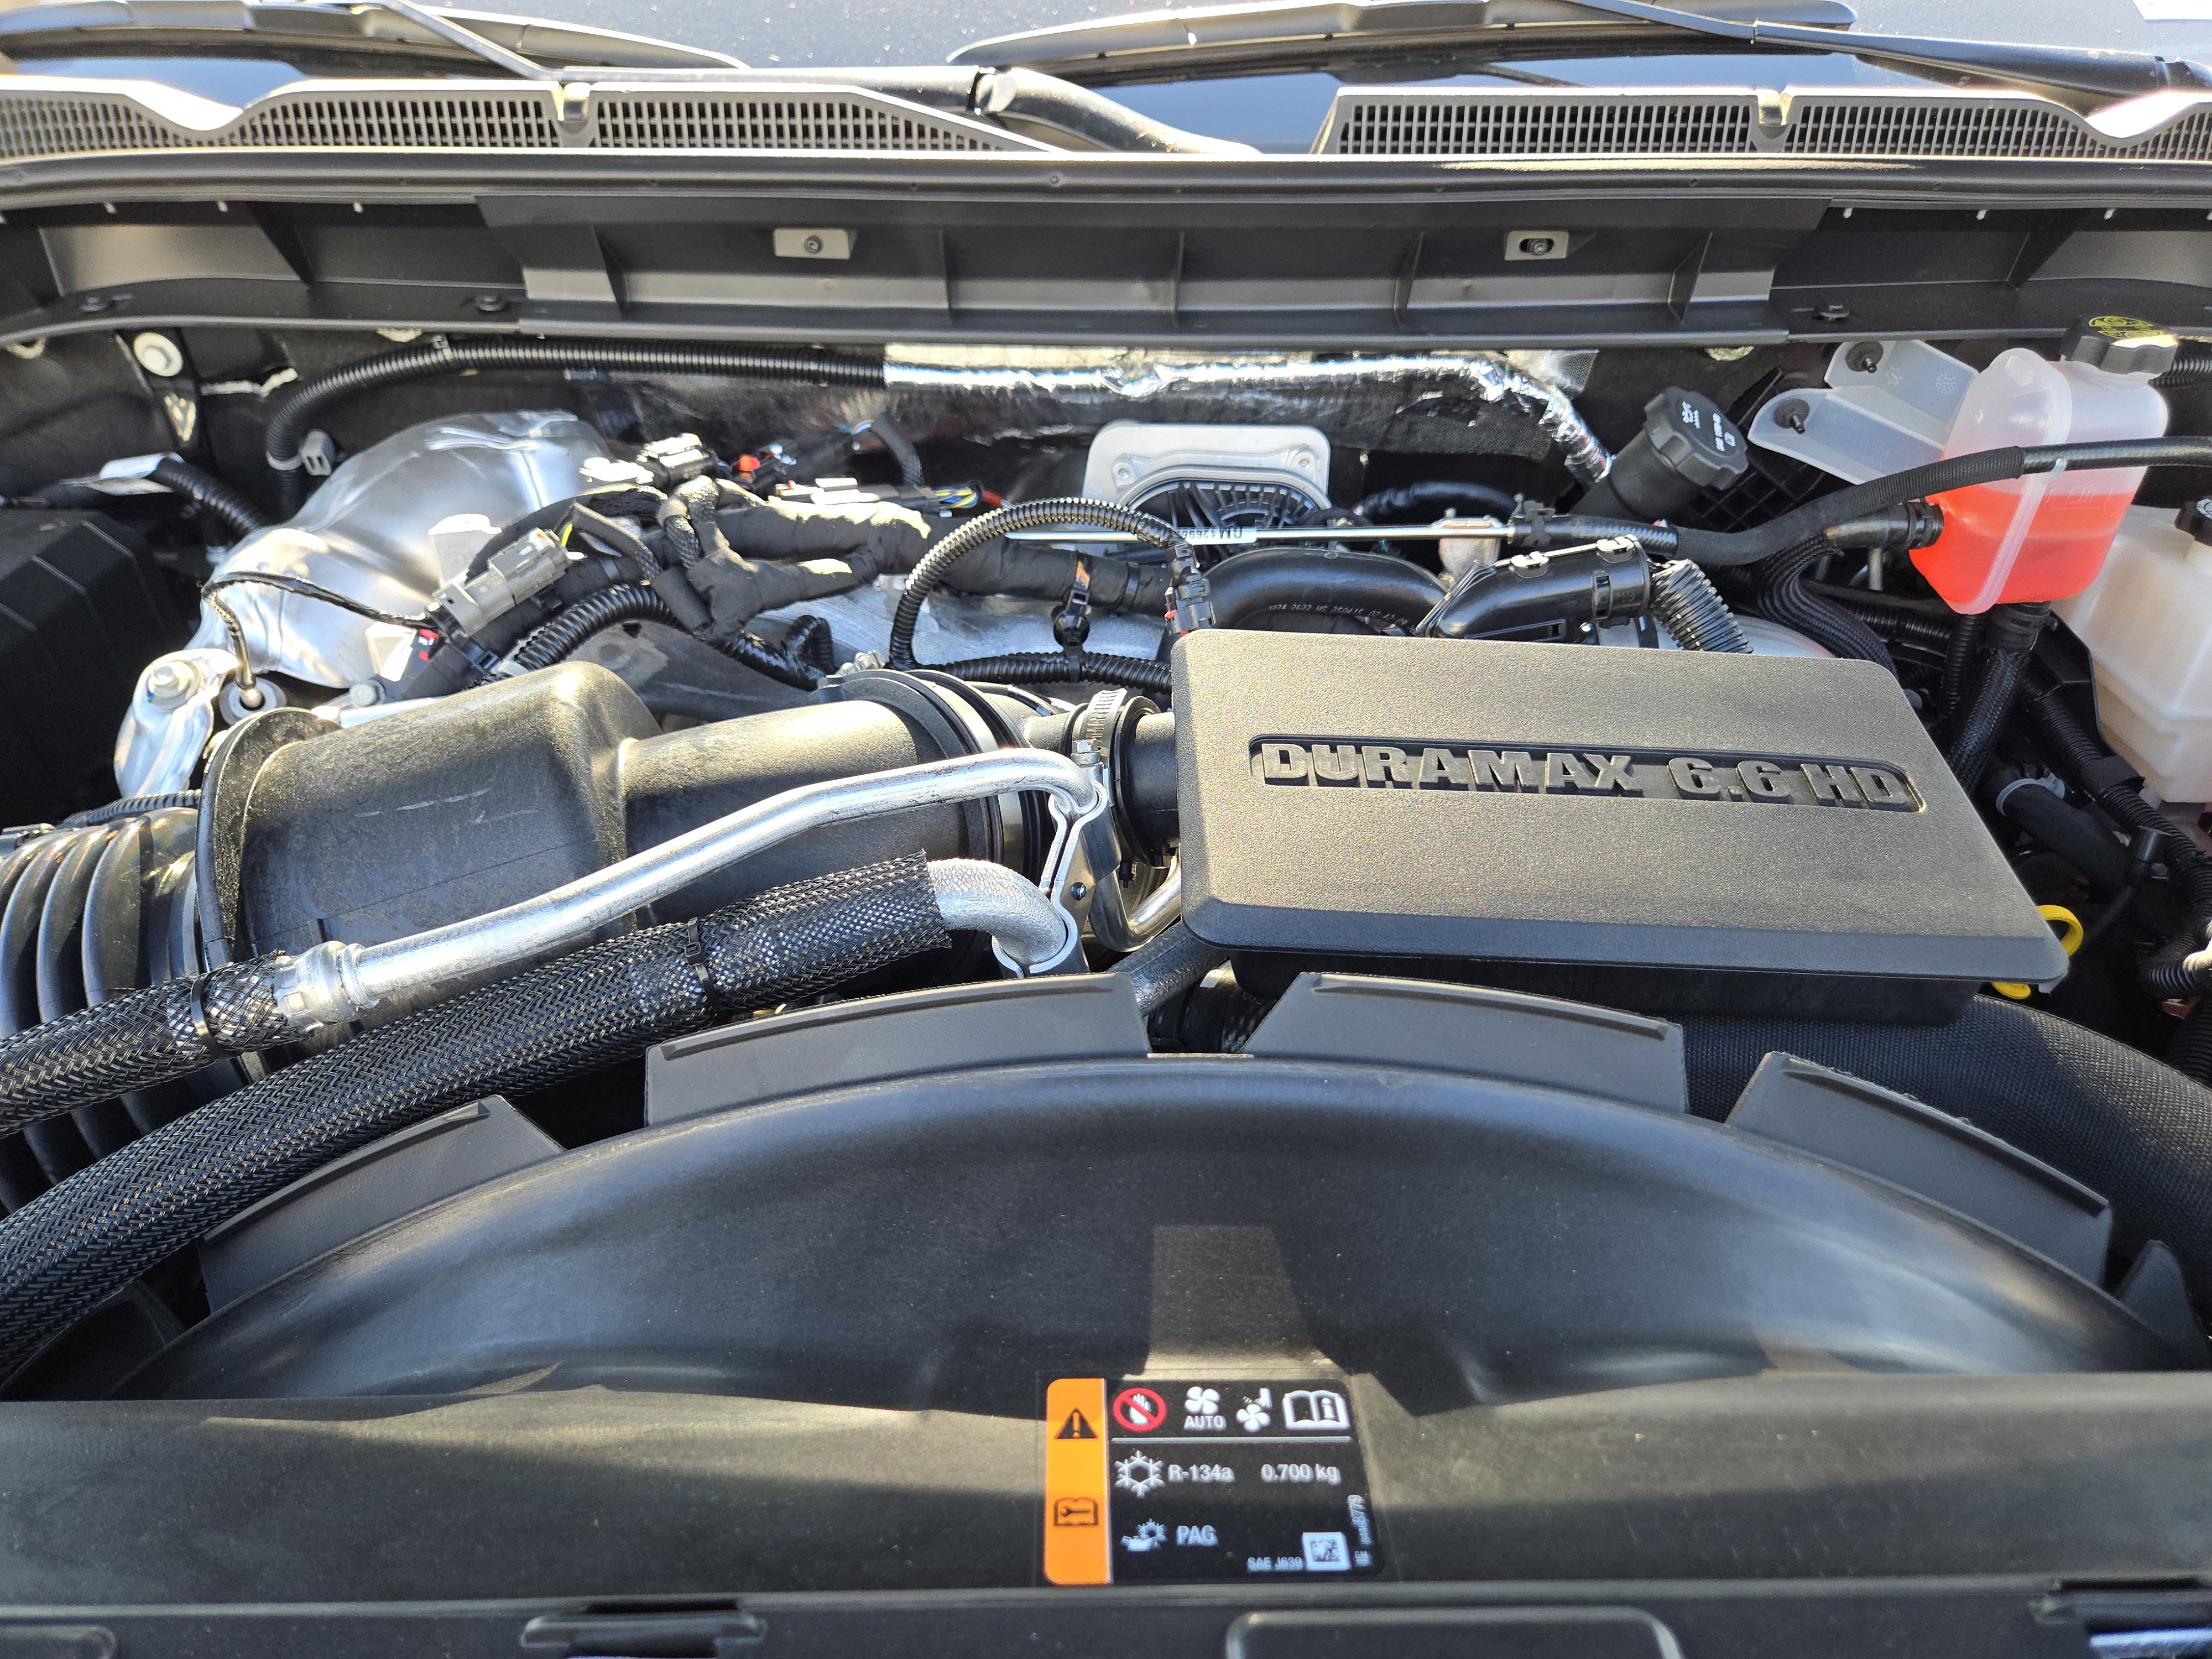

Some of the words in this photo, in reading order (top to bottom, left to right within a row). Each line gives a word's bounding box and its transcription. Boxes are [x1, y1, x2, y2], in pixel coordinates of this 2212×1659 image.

[1261, 743, 1644, 795] DURAMAX
[1667, 757, 1791, 800] 6.6
[1799, 763, 1910, 806] HD
[1183, 1415, 1226, 1430] AUTO
[1168, 1464, 1235, 1482] R-134a
[1261, 1463, 1313, 1482] 0.700
[1314, 1463, 1341, 1485] kg
[1177, 1525, 1218, 1546] PAG
[1246, 1557, 1272, 1571] SAE
[1274, 1557, 1303, 1571] J639
